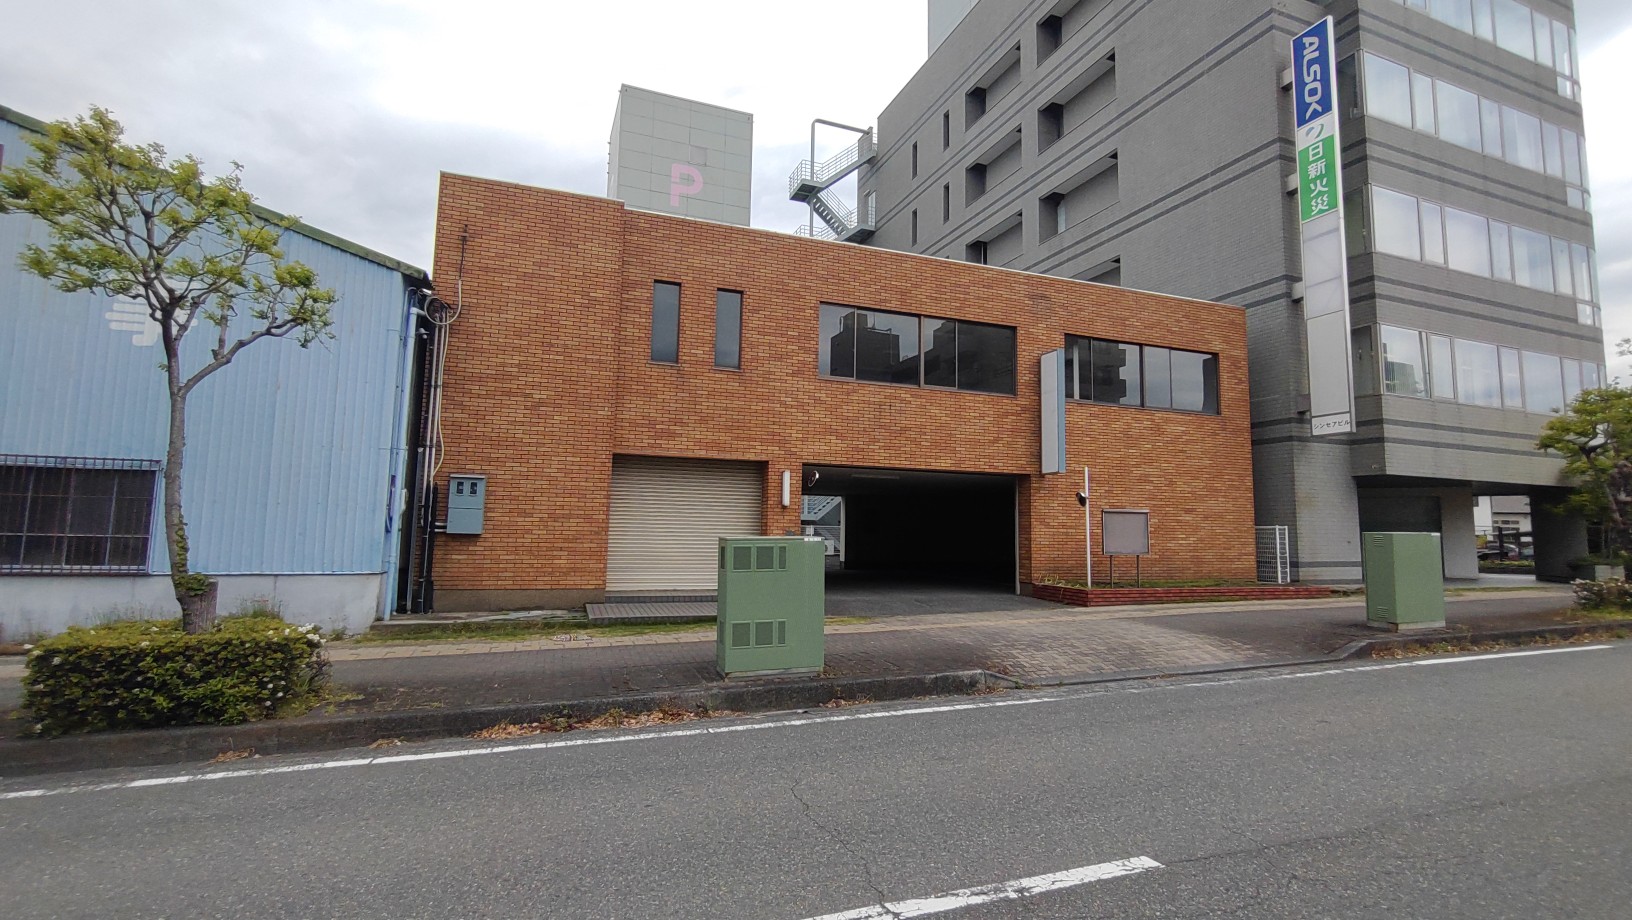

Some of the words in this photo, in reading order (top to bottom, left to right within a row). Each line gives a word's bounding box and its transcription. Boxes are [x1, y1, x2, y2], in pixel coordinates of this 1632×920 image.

[1302, 36, 1322, 120] ALSOK
[671, 163, 703, 207] P
[1308, 141, 1329, 215] 日新火災
[1313, 419, 1351, 430] シンセアビル
